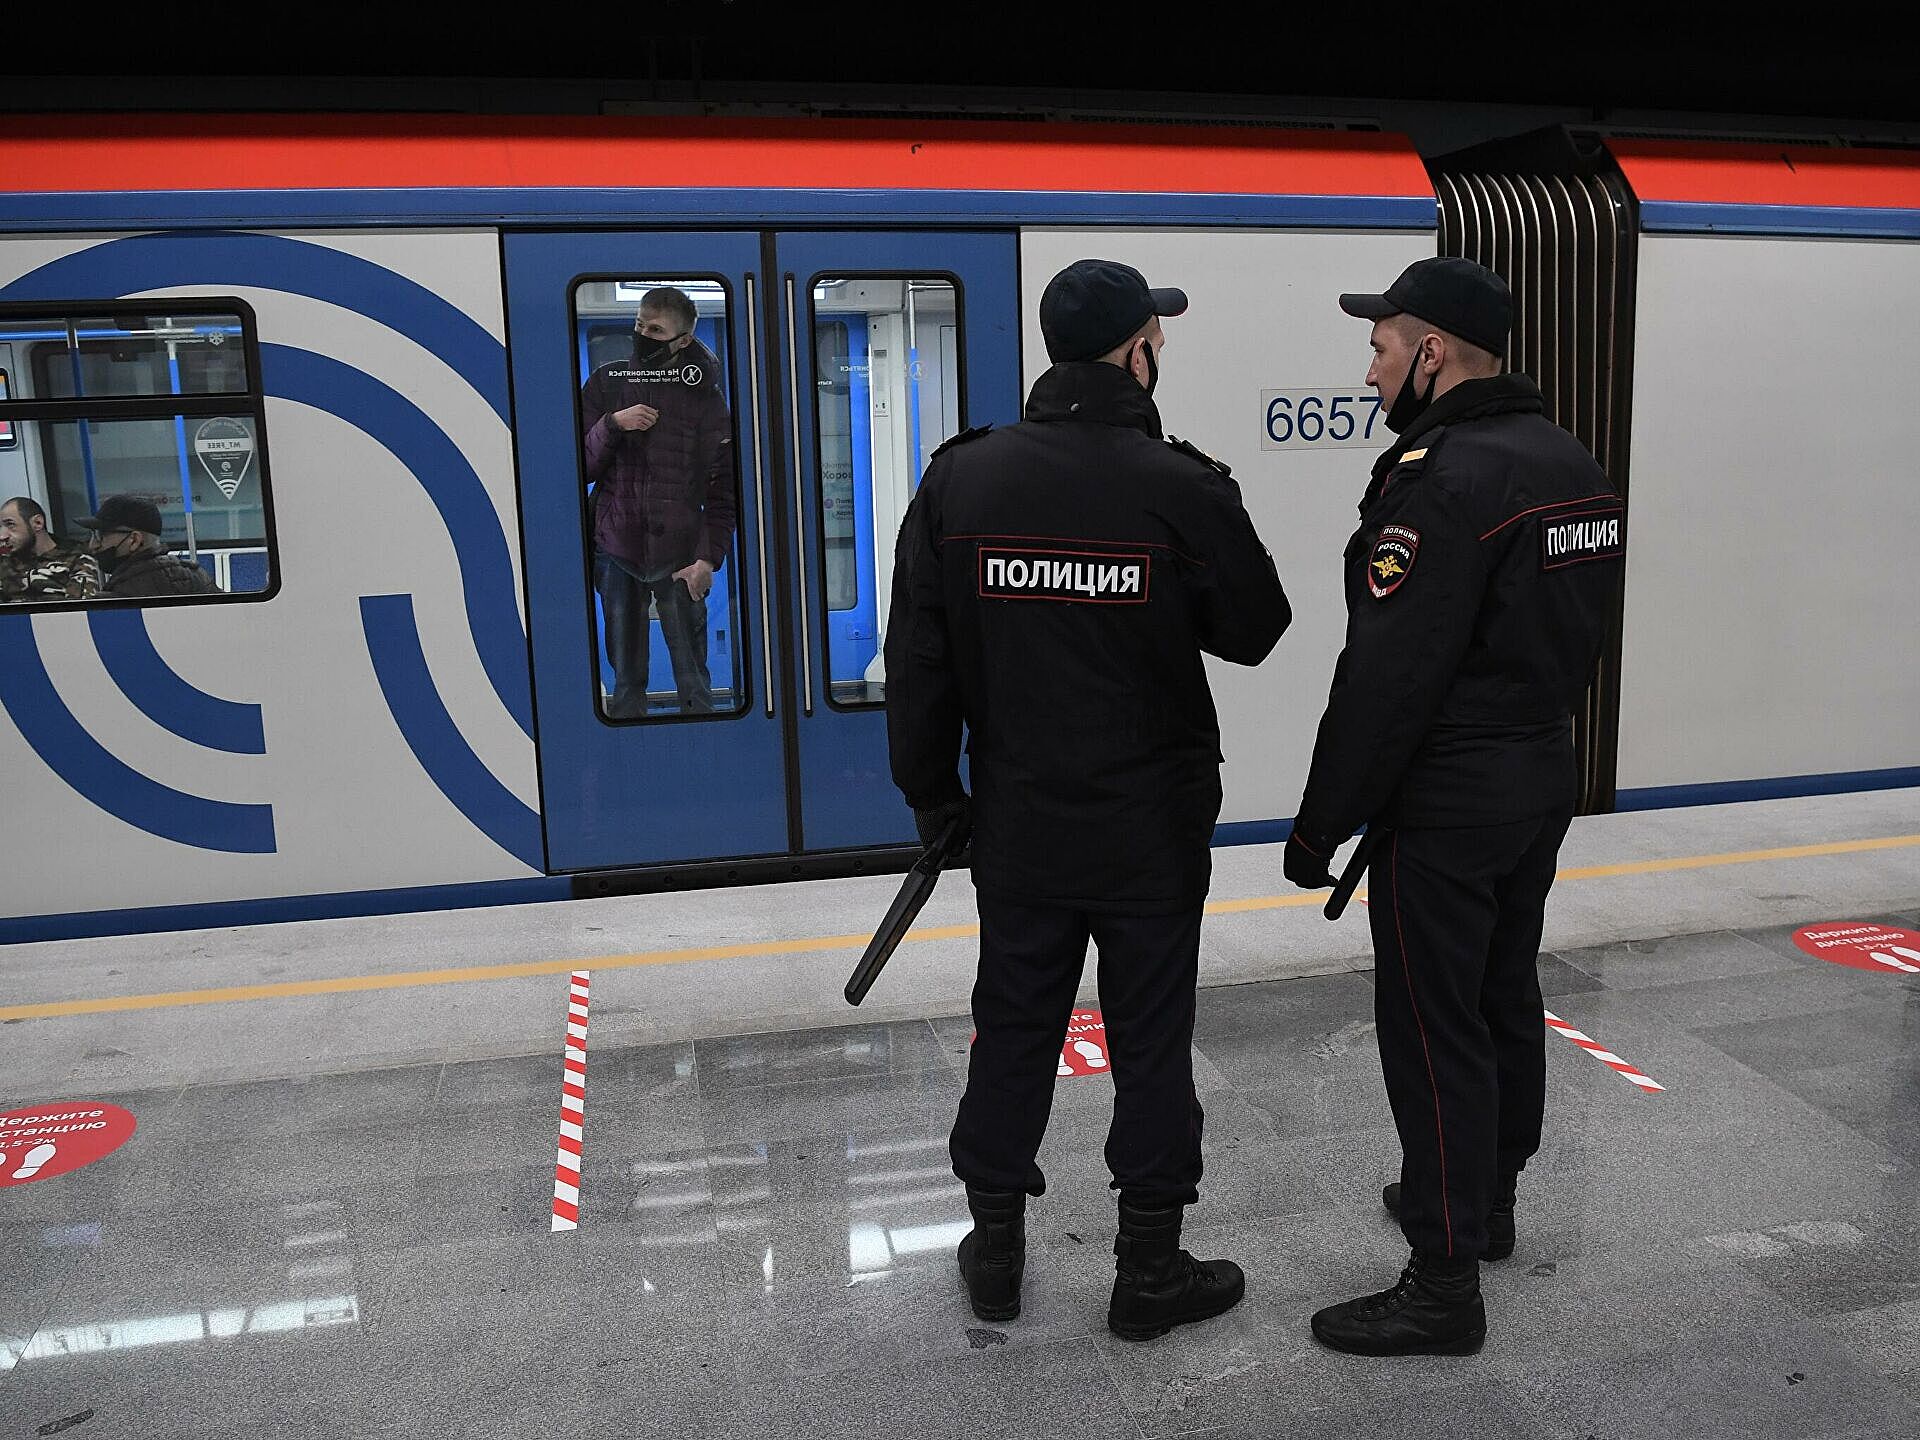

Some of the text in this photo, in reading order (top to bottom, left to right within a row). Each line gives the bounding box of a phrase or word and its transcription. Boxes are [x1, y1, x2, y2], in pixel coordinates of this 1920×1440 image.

[1266, 396, 1384, 442] 6657
[1383, 527, 1418, 543] ПОЛИЦИЯ
[1547, 519, 1619, 555] ПОЛИЦИЯ
[1377, 542, 1410, 560] РОССИЯ
[987, 558, 1140, 597] ПОЛИЦИЯ
[1371, 584, 1387, 598] МВД
[1803, 926, 1881, 940] Держите
[0, 1121, 107, 1138] станцию
